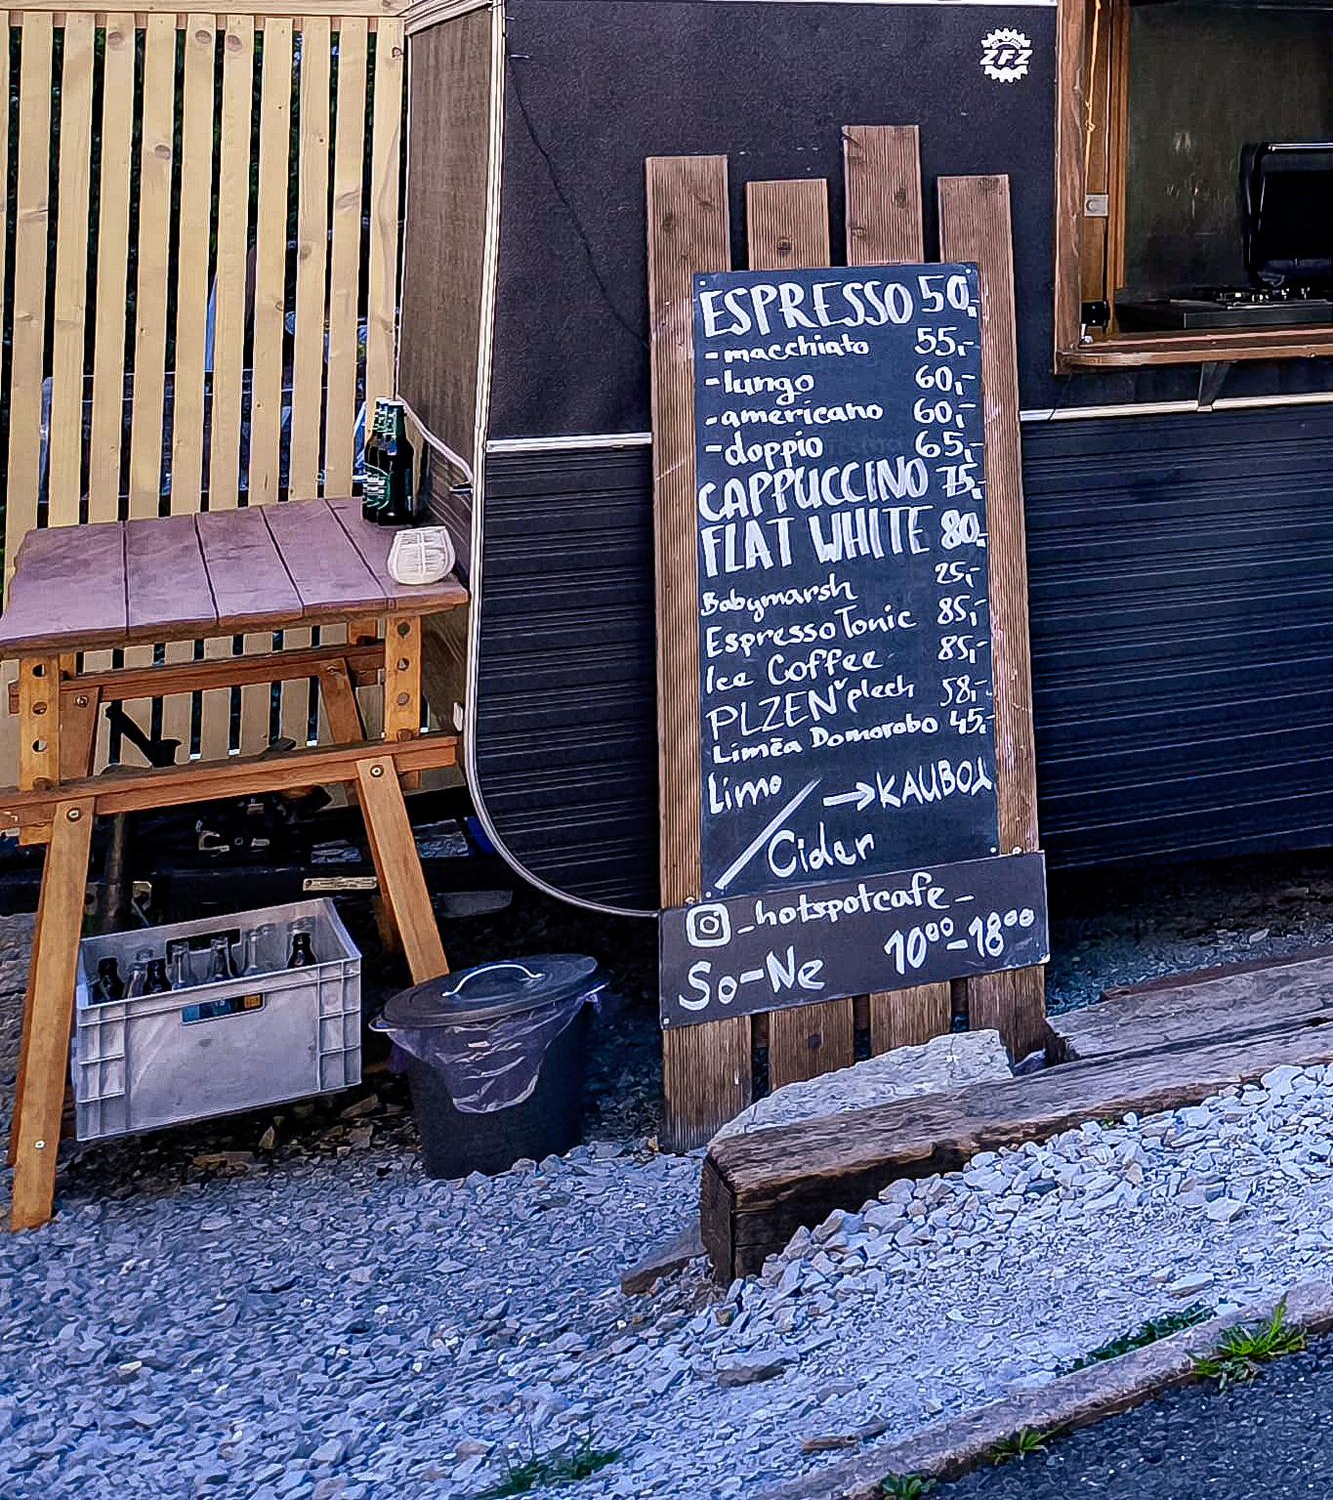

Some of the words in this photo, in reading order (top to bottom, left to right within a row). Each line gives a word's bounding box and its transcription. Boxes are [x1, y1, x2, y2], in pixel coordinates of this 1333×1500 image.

[979, 49, 1033, 65] ZFZ
[699, 281, 914, 338] ESPRESSO
[698, 456, 929, 522] CAPPUCCINO
[701, 516, 795, 578] FLAT
[808, 505, 934, 565] WHITE
[700, 573, 858, 622] Babymarsh
[706, 665, 755, 694] Ice
[767, 649, 884, 686] Coffee
[846, 675, 914, 713] plech
[708, 771, 783, 814] Limo
[768, 821, 875, 878] Cider
[678, 945, 826, 1012] So-Ne
